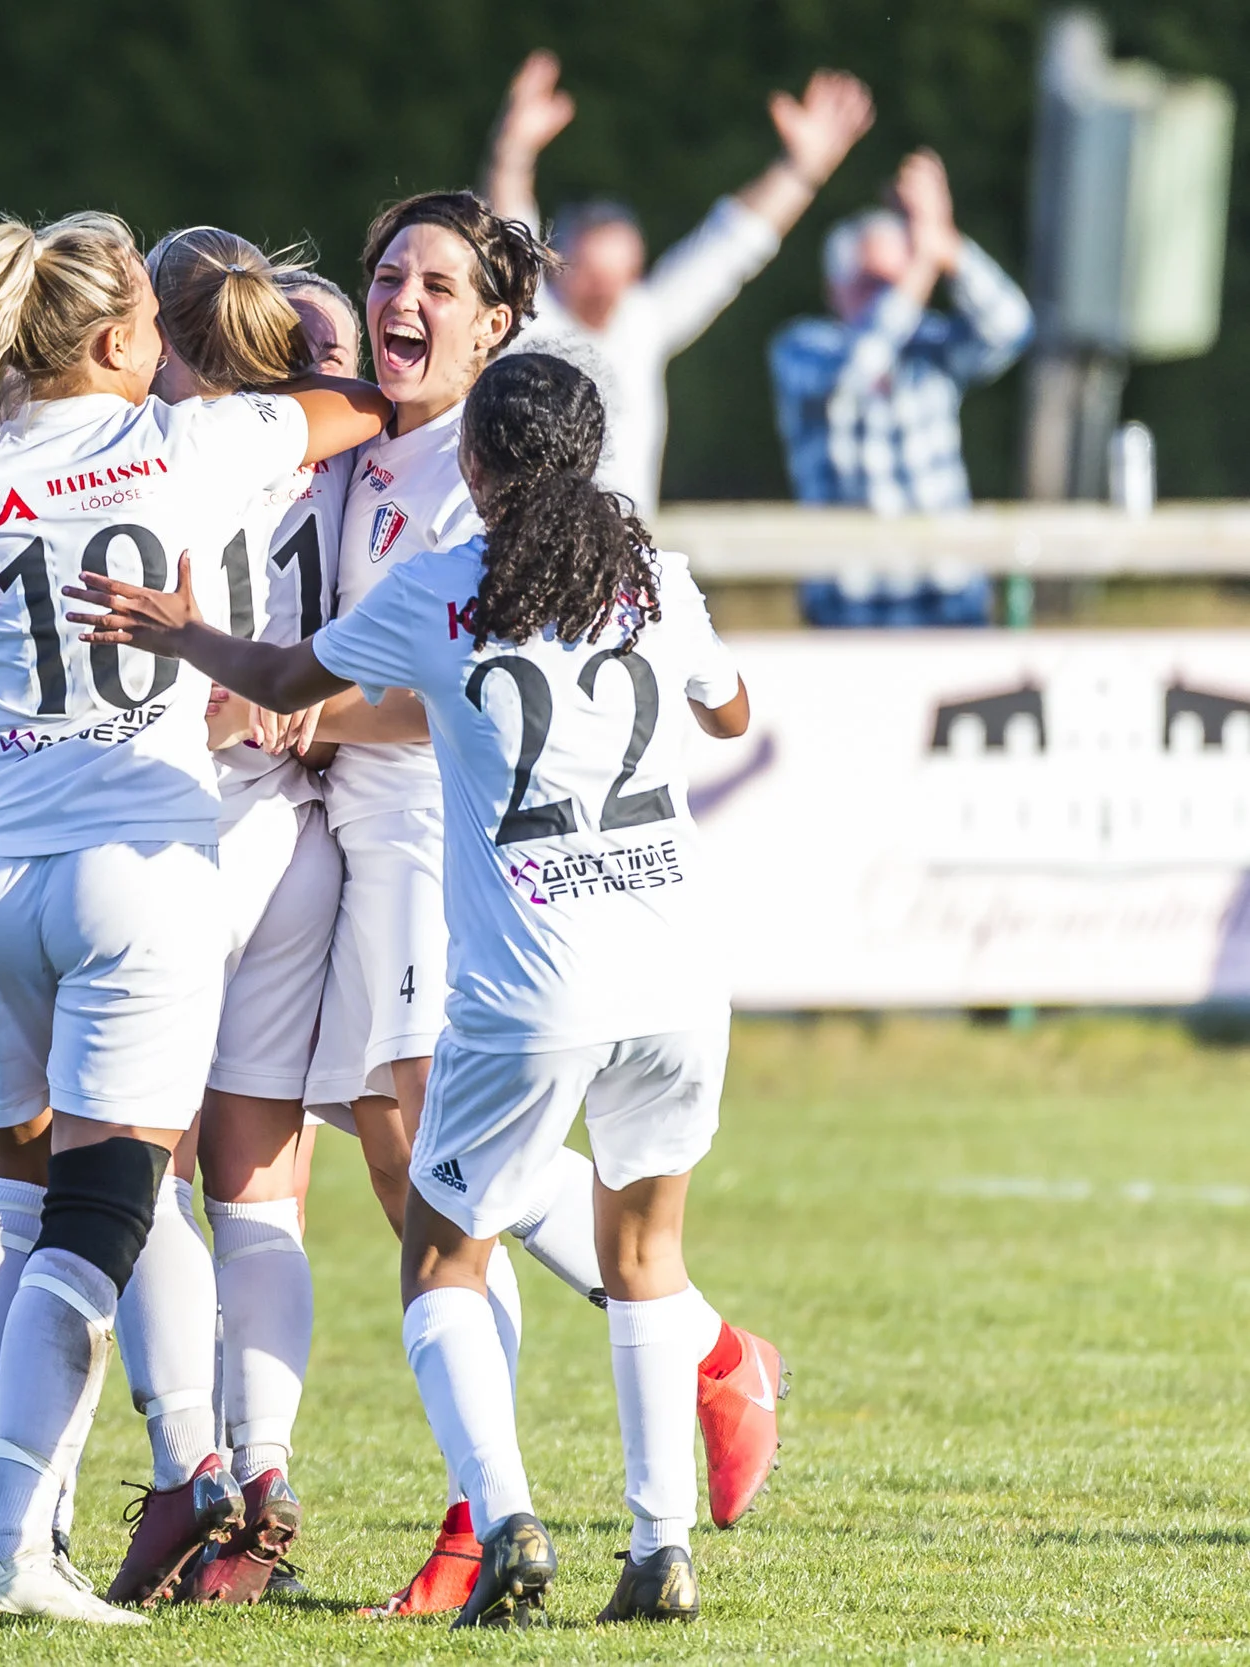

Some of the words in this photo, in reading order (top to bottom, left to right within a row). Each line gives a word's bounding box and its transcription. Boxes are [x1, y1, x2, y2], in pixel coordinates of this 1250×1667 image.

[81, 488, 142, 512] LÖDÖSE
[465, 648, 676, 847] 22
[542, 840, 677, 884] ANYTIME
[548, 865, 683, 902] FITNESS
[400, 965, 415, 1004] 4
[431, 1167, 468, 1193] adidas
